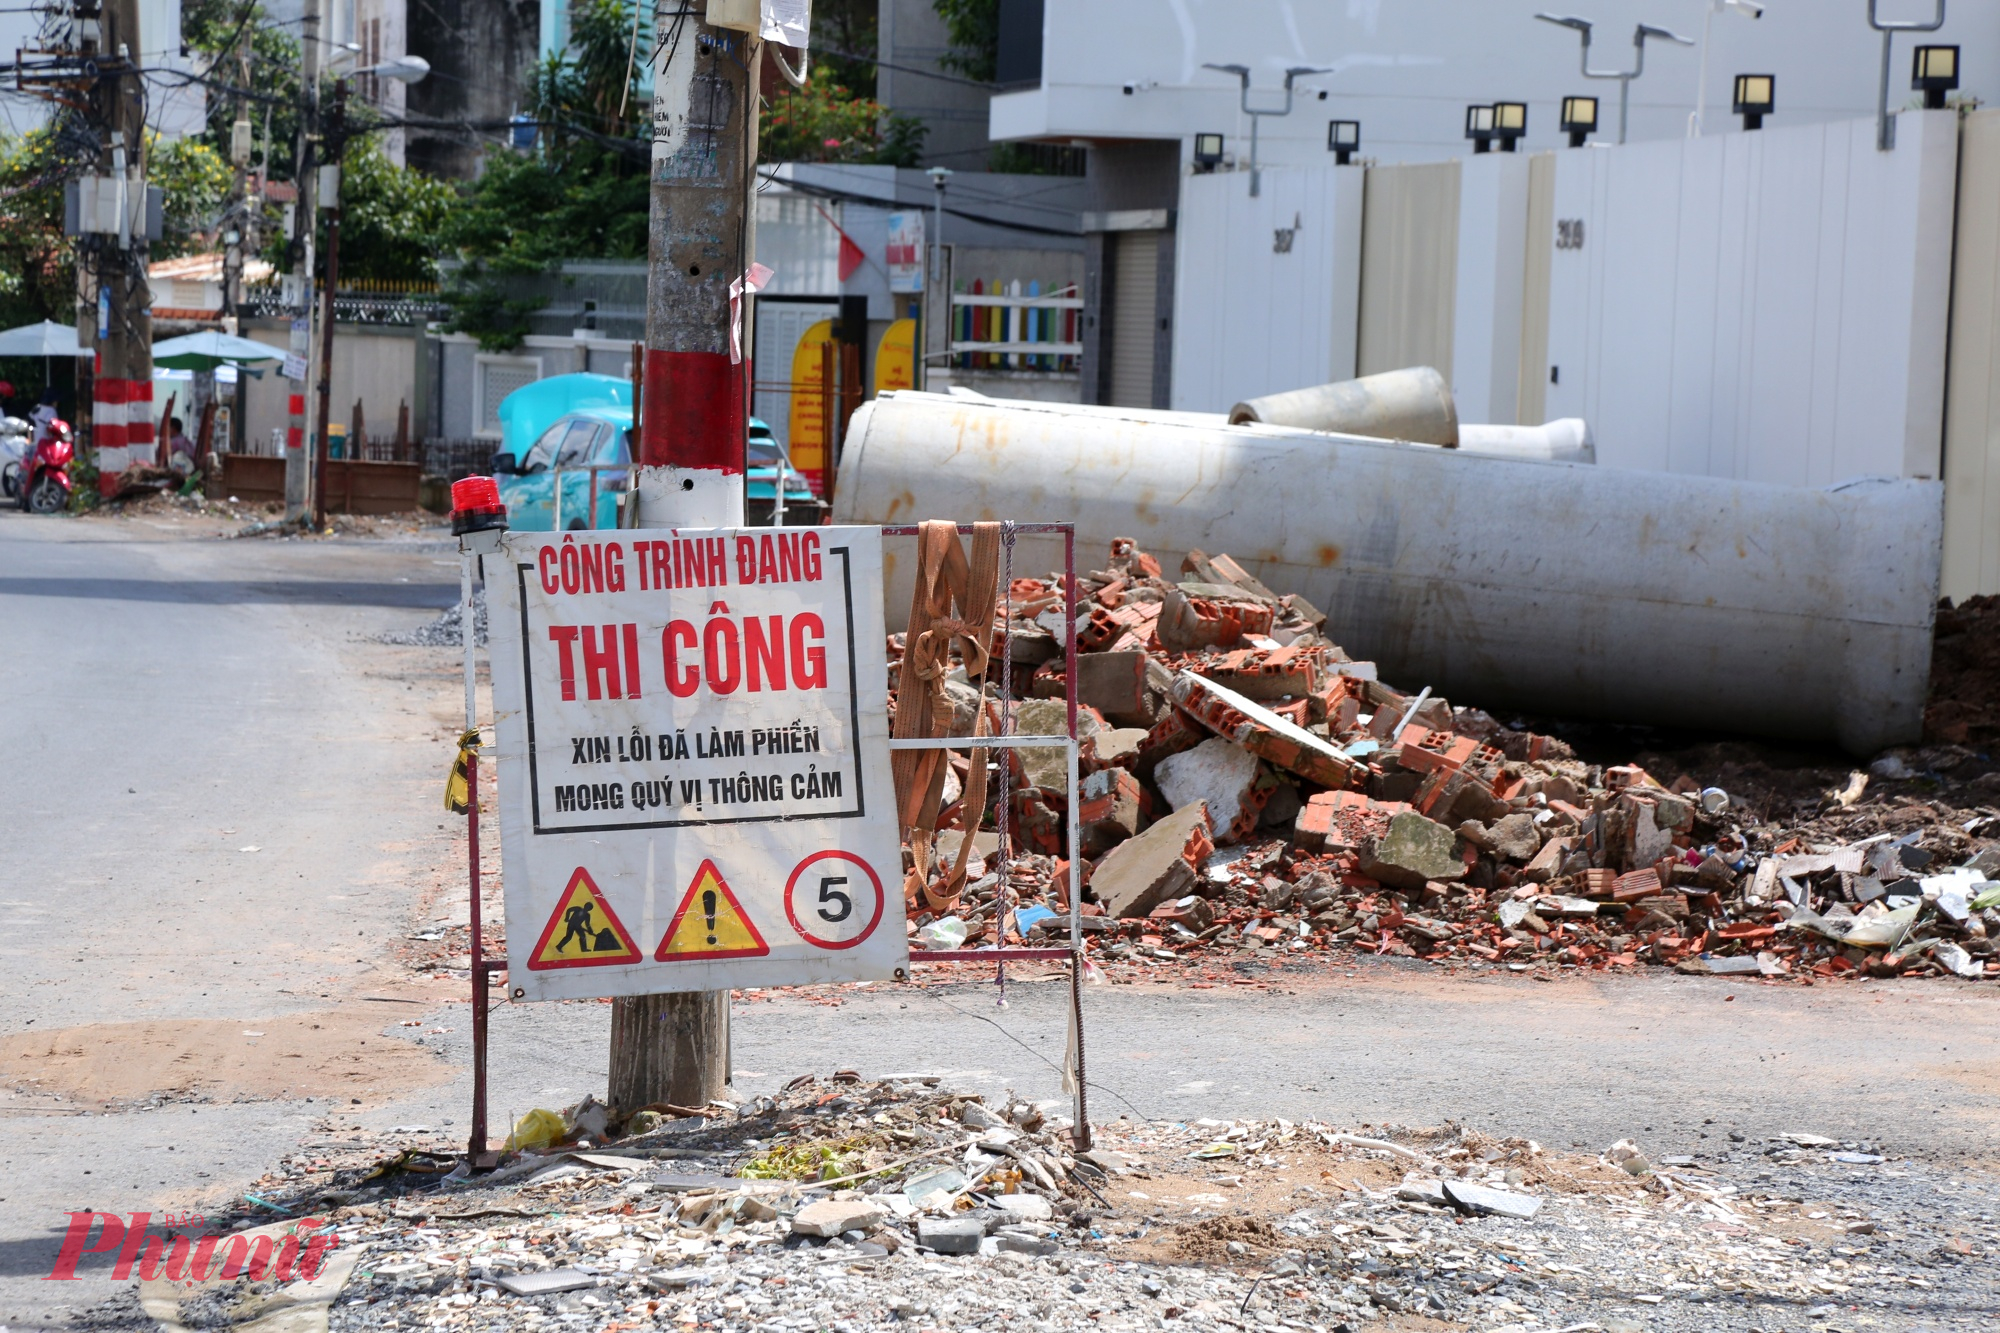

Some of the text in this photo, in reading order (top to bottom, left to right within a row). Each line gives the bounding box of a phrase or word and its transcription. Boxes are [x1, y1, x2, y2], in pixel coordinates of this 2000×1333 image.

[539, 529, 823, 595] CÔNG TRÌNH ĐANG
[549, 600, 829, 701] THI CÔNG
[571, 736, 611, 765] XIN
[618, 725, 652, 762] LỖI
[658, 731, 691, 761] ĐÃ
[695, 728, 745, 759] LÀM
[555, 763, 843, 813] MONG QUÝ VỊ THÔNG CẢM
[817, 876, 852, 923] 5
